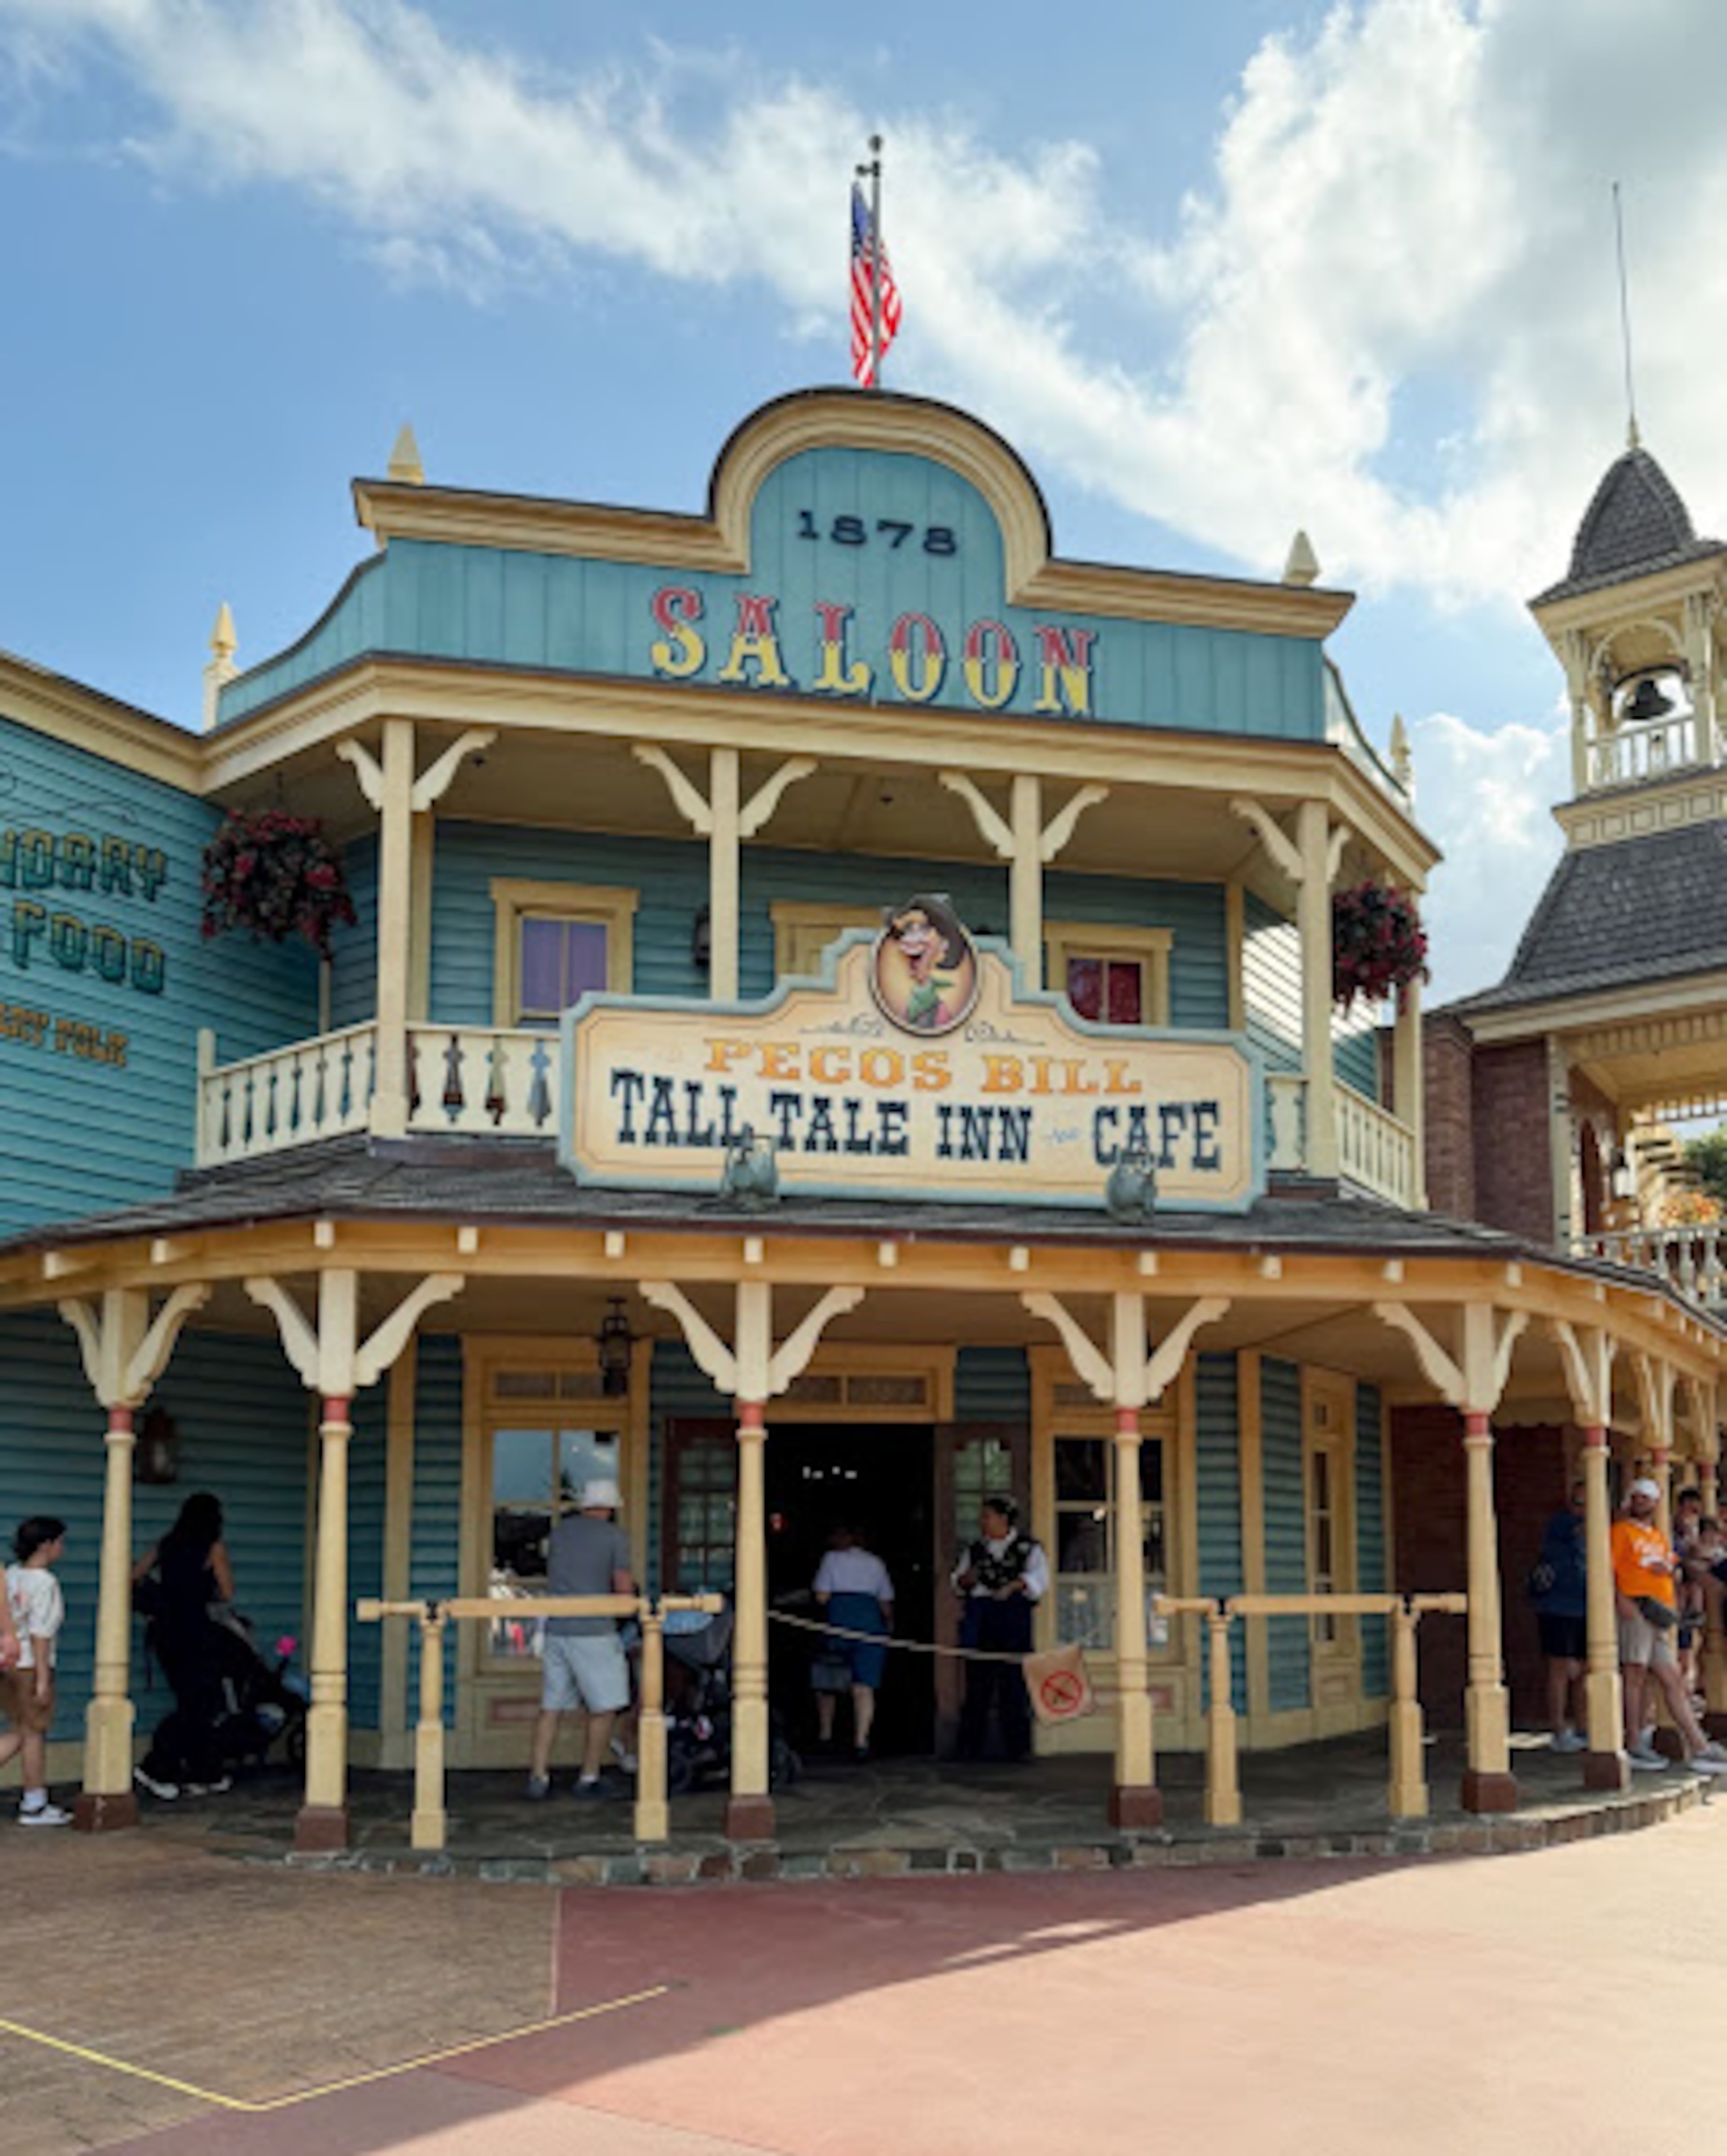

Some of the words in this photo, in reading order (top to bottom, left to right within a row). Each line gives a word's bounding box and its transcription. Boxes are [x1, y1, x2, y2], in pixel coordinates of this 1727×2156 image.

[798, 510, 959, 557] 1878
[651, 586, 1099, 719] SALOON
[13, 900, 165, 994] FOOD
[703, 1037, 953, 1093] PECOS
[980, 1054, 1142, 1095] BILL
[610, 1067, 754, 1149] TALL
[768, 1089, 909, 1156] TALE
[935, 1103, 1032, 1164] INN
[1093, 1100, 1221, 1172] CAFE
